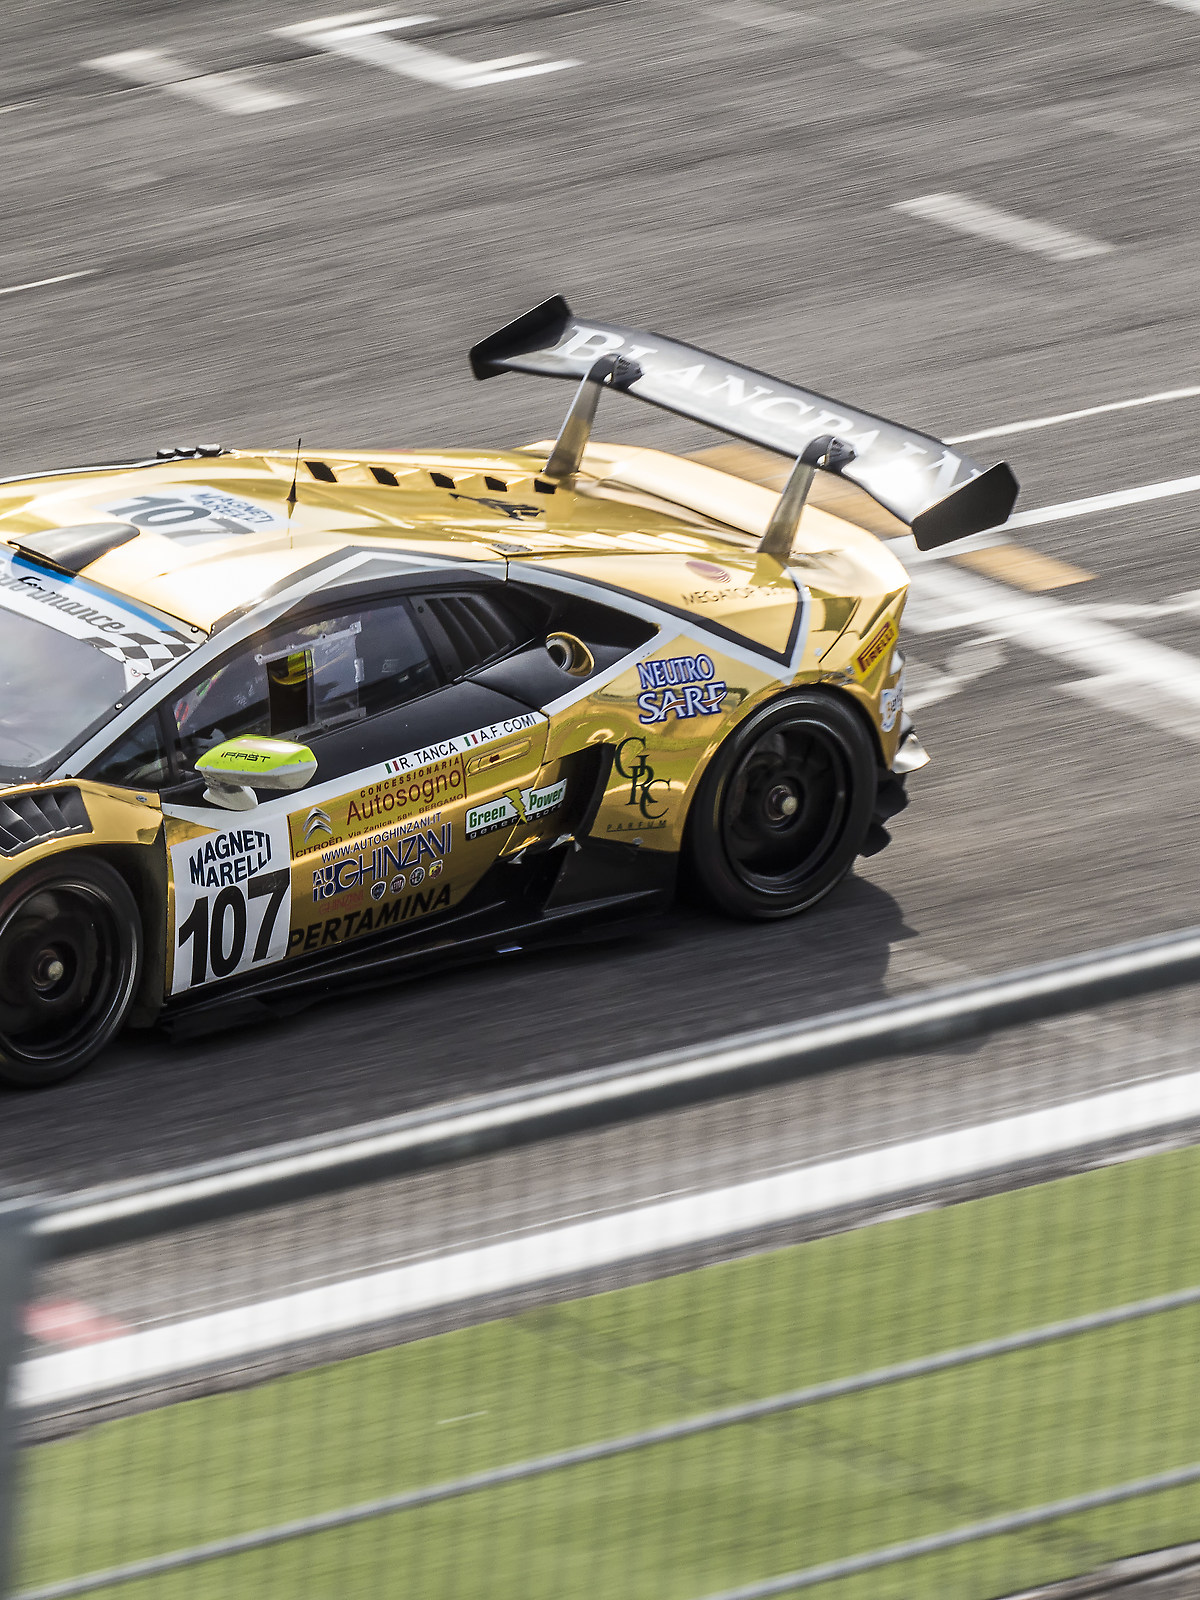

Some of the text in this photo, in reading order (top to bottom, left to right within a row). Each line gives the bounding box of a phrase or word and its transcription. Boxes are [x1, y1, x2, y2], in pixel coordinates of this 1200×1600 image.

[107, 496, 256, 540] 107
[637, 654, 714, 689] NEUTRO
[480, 714, 537, 741] A.F. COMI
[399, 742, 458, 769] R. TANCA
[346, 769, 461, 826] Autosogno
[360, 757, 460, 798] CONCESSIONARIA
[348, 831, 362, 839] Via
[419, 794, 464, 813] BERGAMO
[469, 787, 563, 828] Green Power
[606, 820, 667, 830] PARFUM
[189, 830, 272, 872] MAGNETI
[321, 811, 442, 863] WWW.AUTOGHINZANI.IT
[337, 822, 452, 889] GHINZANI
[189, 850, 268, 887] MARELLI
[179, 868, 290, 986] 107
[287, 883, 452, 953] PERTAMINA
